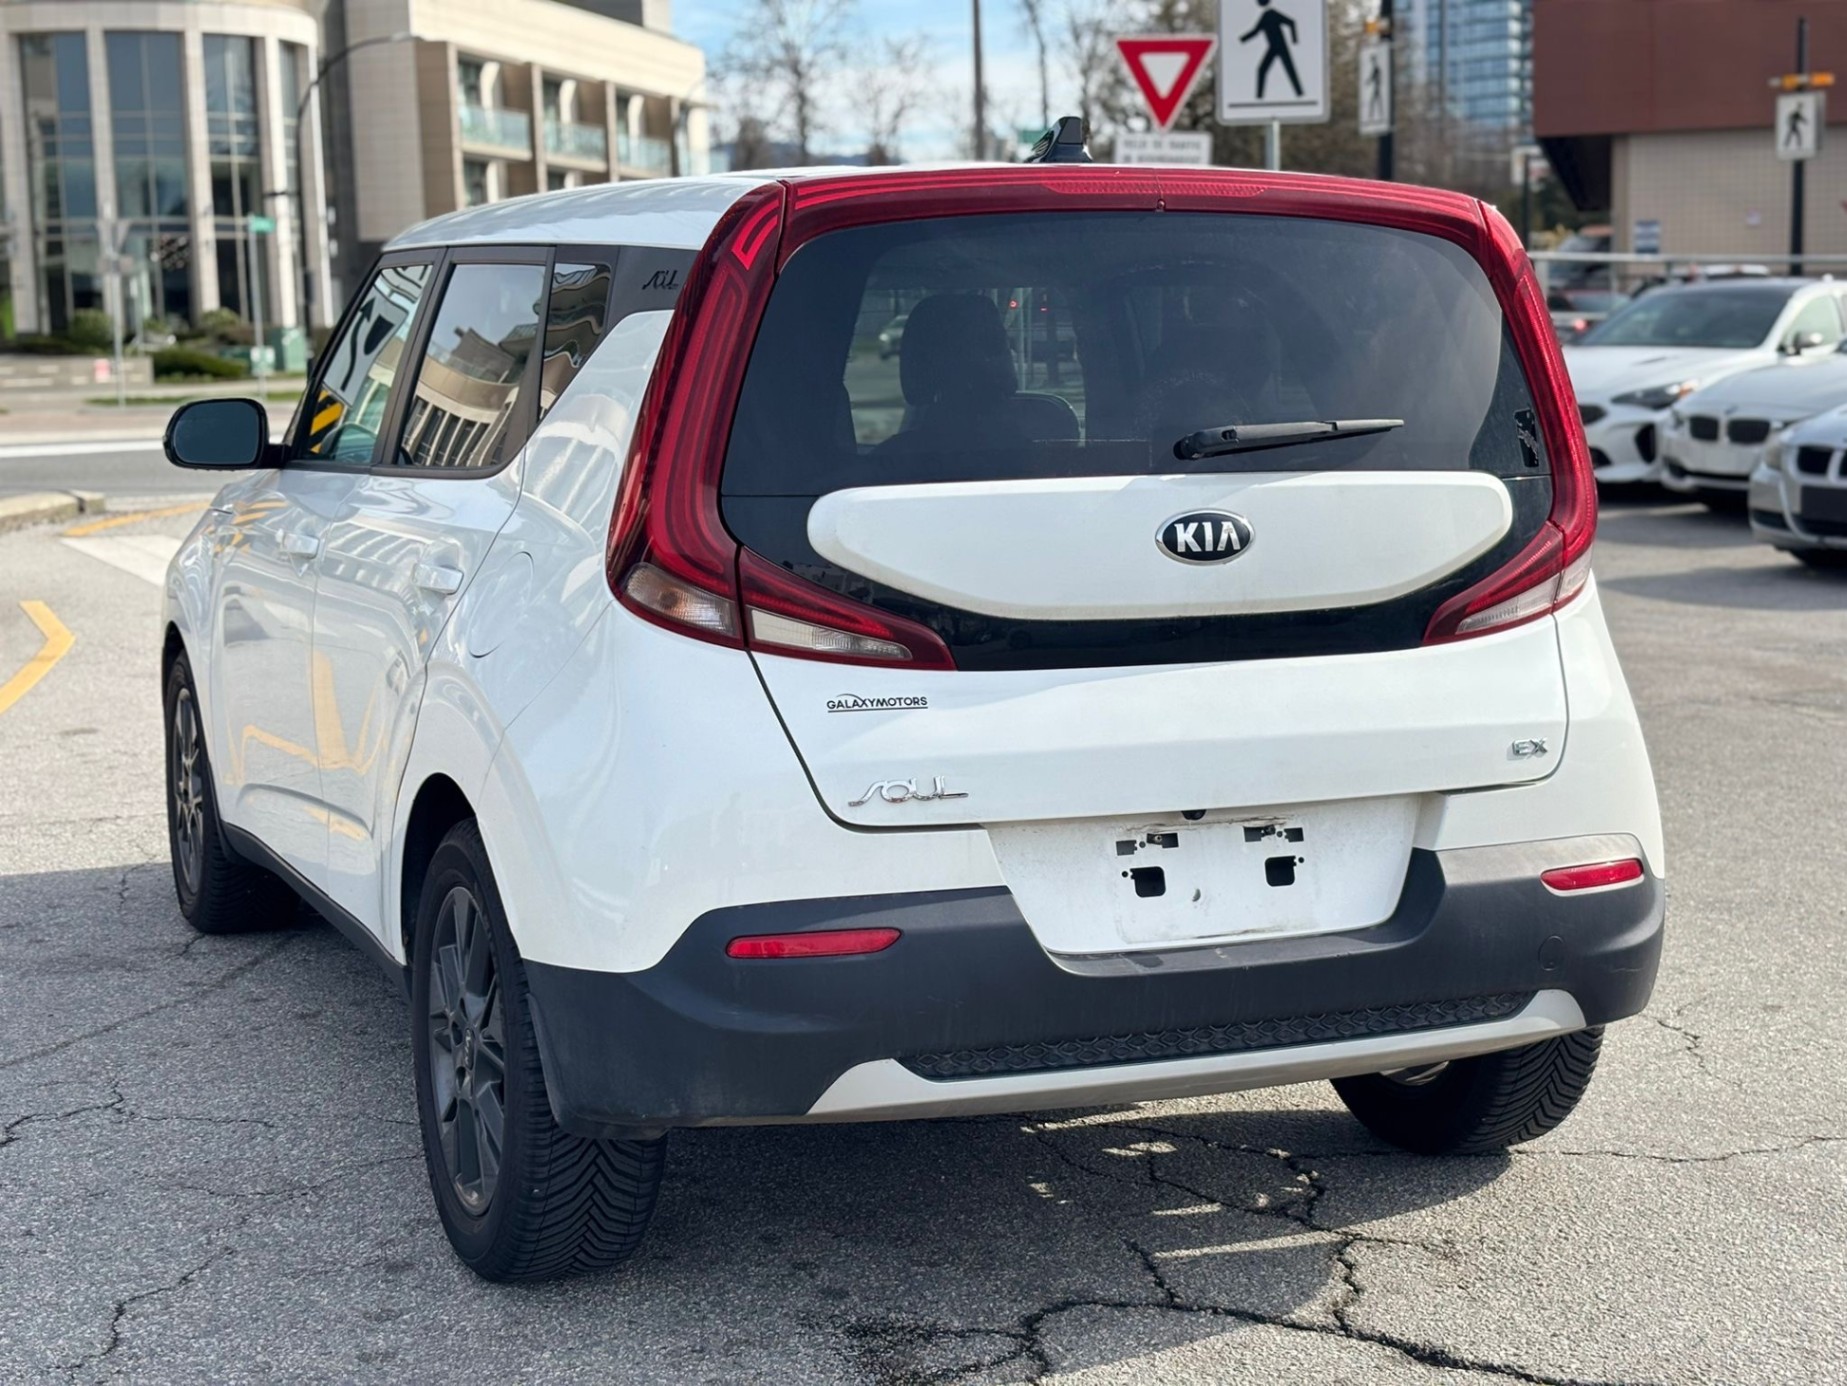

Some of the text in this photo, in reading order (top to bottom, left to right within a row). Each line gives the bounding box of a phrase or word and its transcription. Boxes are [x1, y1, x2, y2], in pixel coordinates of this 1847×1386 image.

[1174, 521, 1241, 552] KIA
[1511, 738, 1548, 757] EX
[848, 775, 969, 806] SOUL
